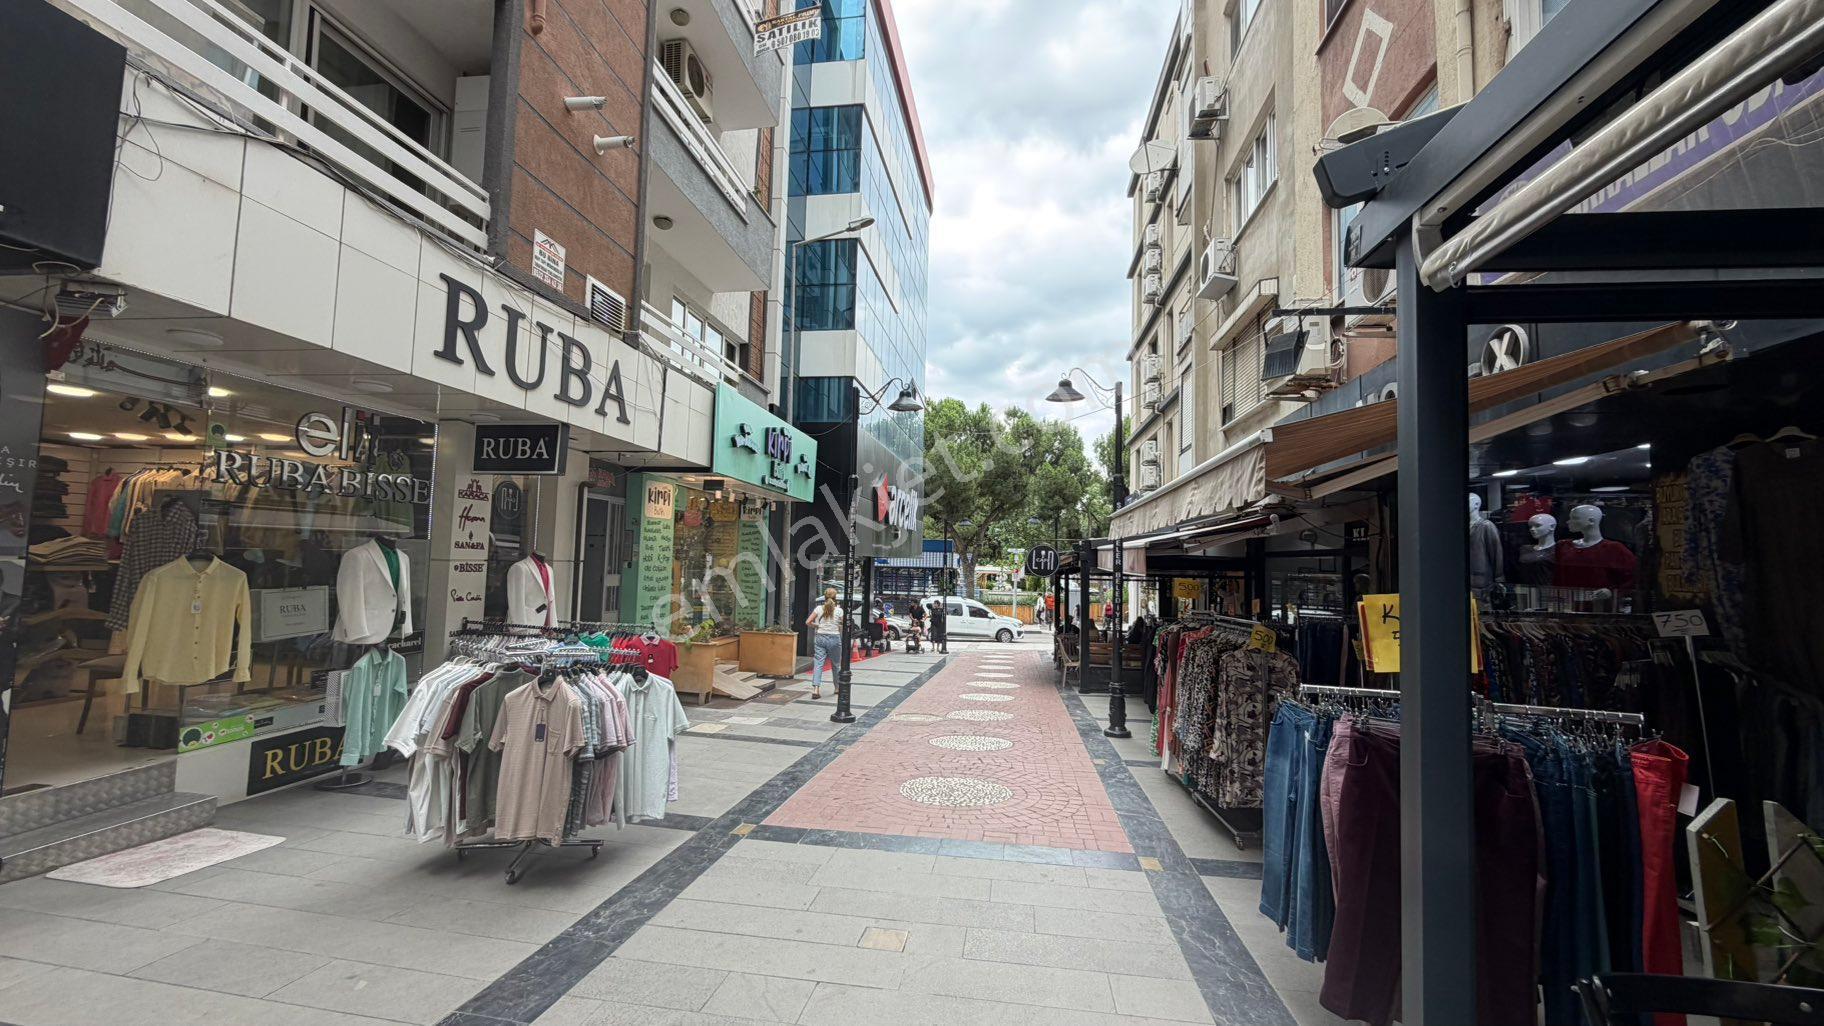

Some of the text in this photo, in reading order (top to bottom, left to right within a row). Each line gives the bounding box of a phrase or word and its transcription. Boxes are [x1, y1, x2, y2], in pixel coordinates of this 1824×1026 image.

[756, 18, 819, 43] SATILIK
[433, 272, 631, 425] RUBA
[481, 437, 550, 460] RUBA
[765, 427, 793, 465] kirpi
[0, 456, 38, 468] ŞIR
[210, 449, 332, 496] RUBA
[648, 487, 671, 506] kirpi
[1656, 613, 1704, 629] 750
